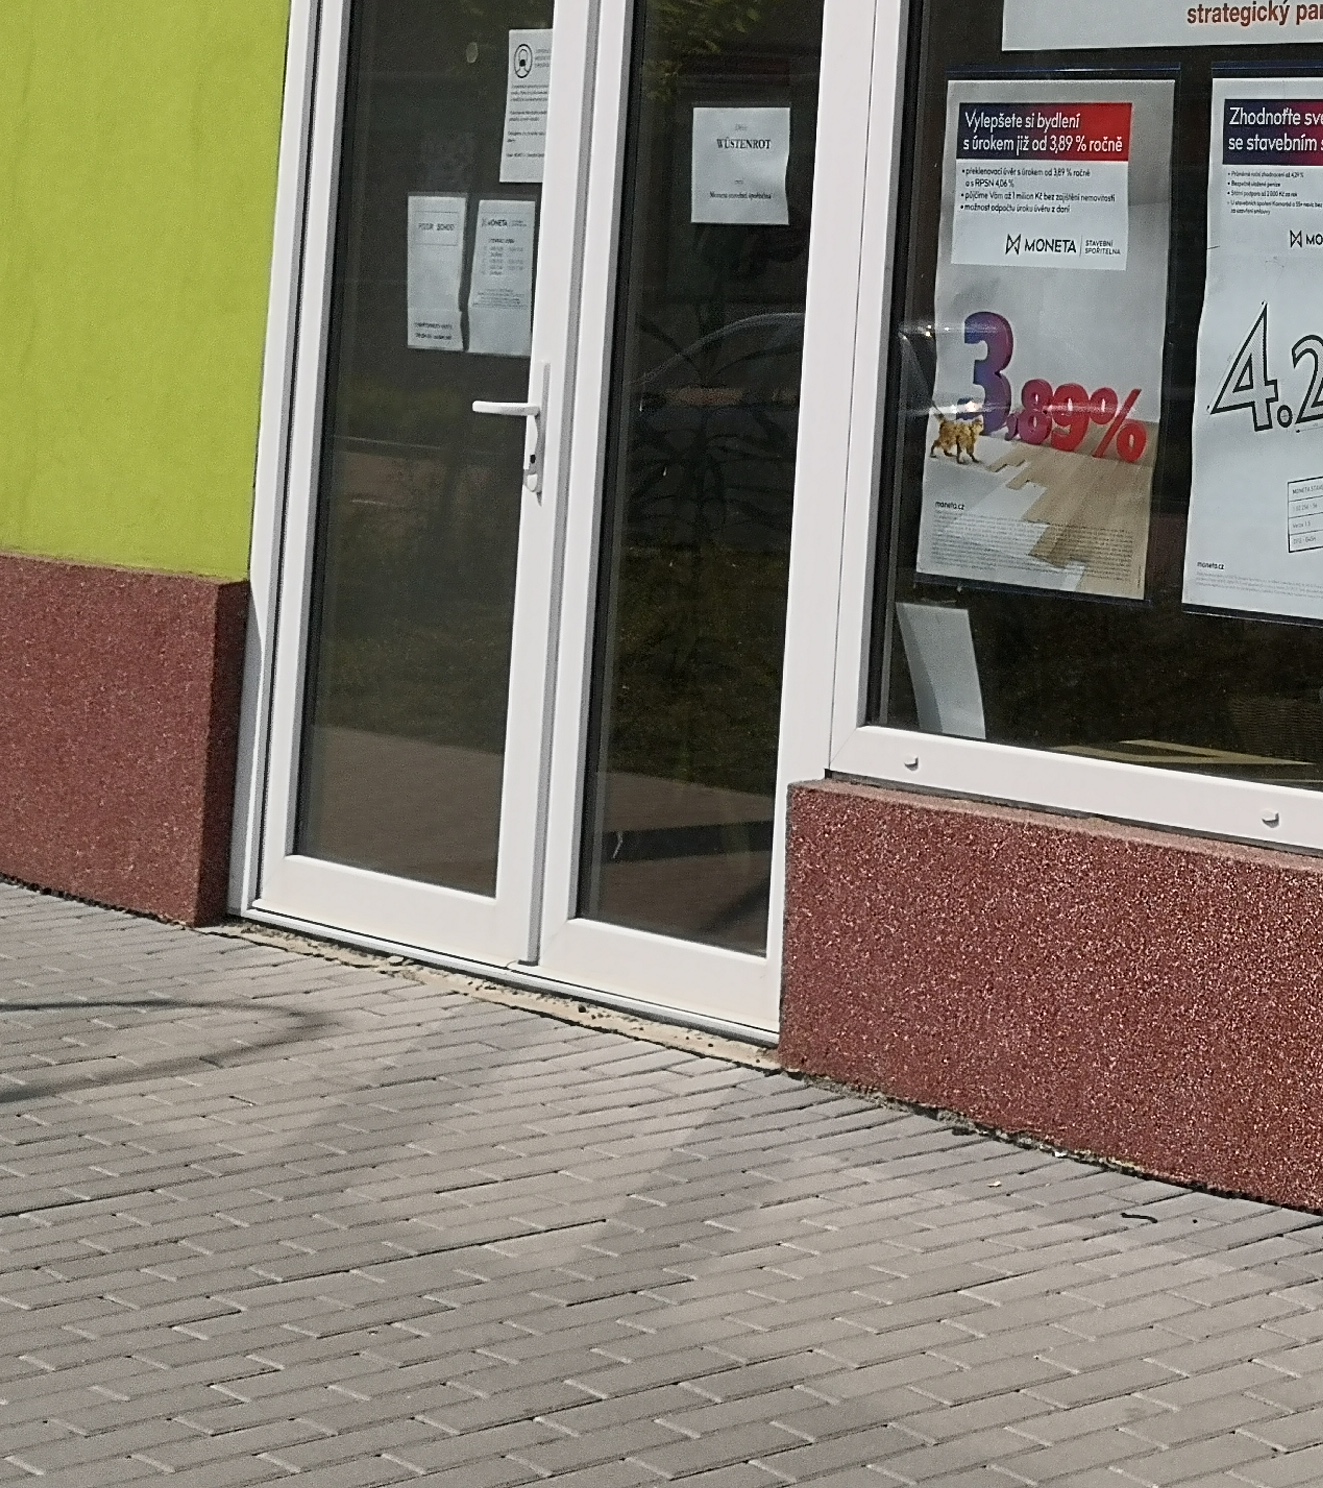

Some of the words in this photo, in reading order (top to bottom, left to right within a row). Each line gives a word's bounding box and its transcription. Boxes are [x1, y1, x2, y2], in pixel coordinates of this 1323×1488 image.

[1187, 0, 1289, 26] strategický
[965, 109, 1022, 133] Vylepšete
[1025, 113, 1034, 128] si
[1037, 112, 1080, 133] bydlení
[1229, 107, 1301, 126] Zhodnoťte
[716, 137, 771, 149] WÜSTENROT
[963, 139, 969, 150] s
[972, 135, 1014, 151] úrokem
[1016, 135, 1029, 156] již
[1032, 136, 1047, 151] od
[1050, 135, 1072, 154] 3,89
[1076, 136, 1087, 152] %
[1089, 136, 1123, 152] ročně
[1228, 137, 1243, 150] se
[1246, 133, 1317, 152] stavebním
[975, 178, 994, 187] RPSN
[1025, 238, 1076, 253] MONETA
